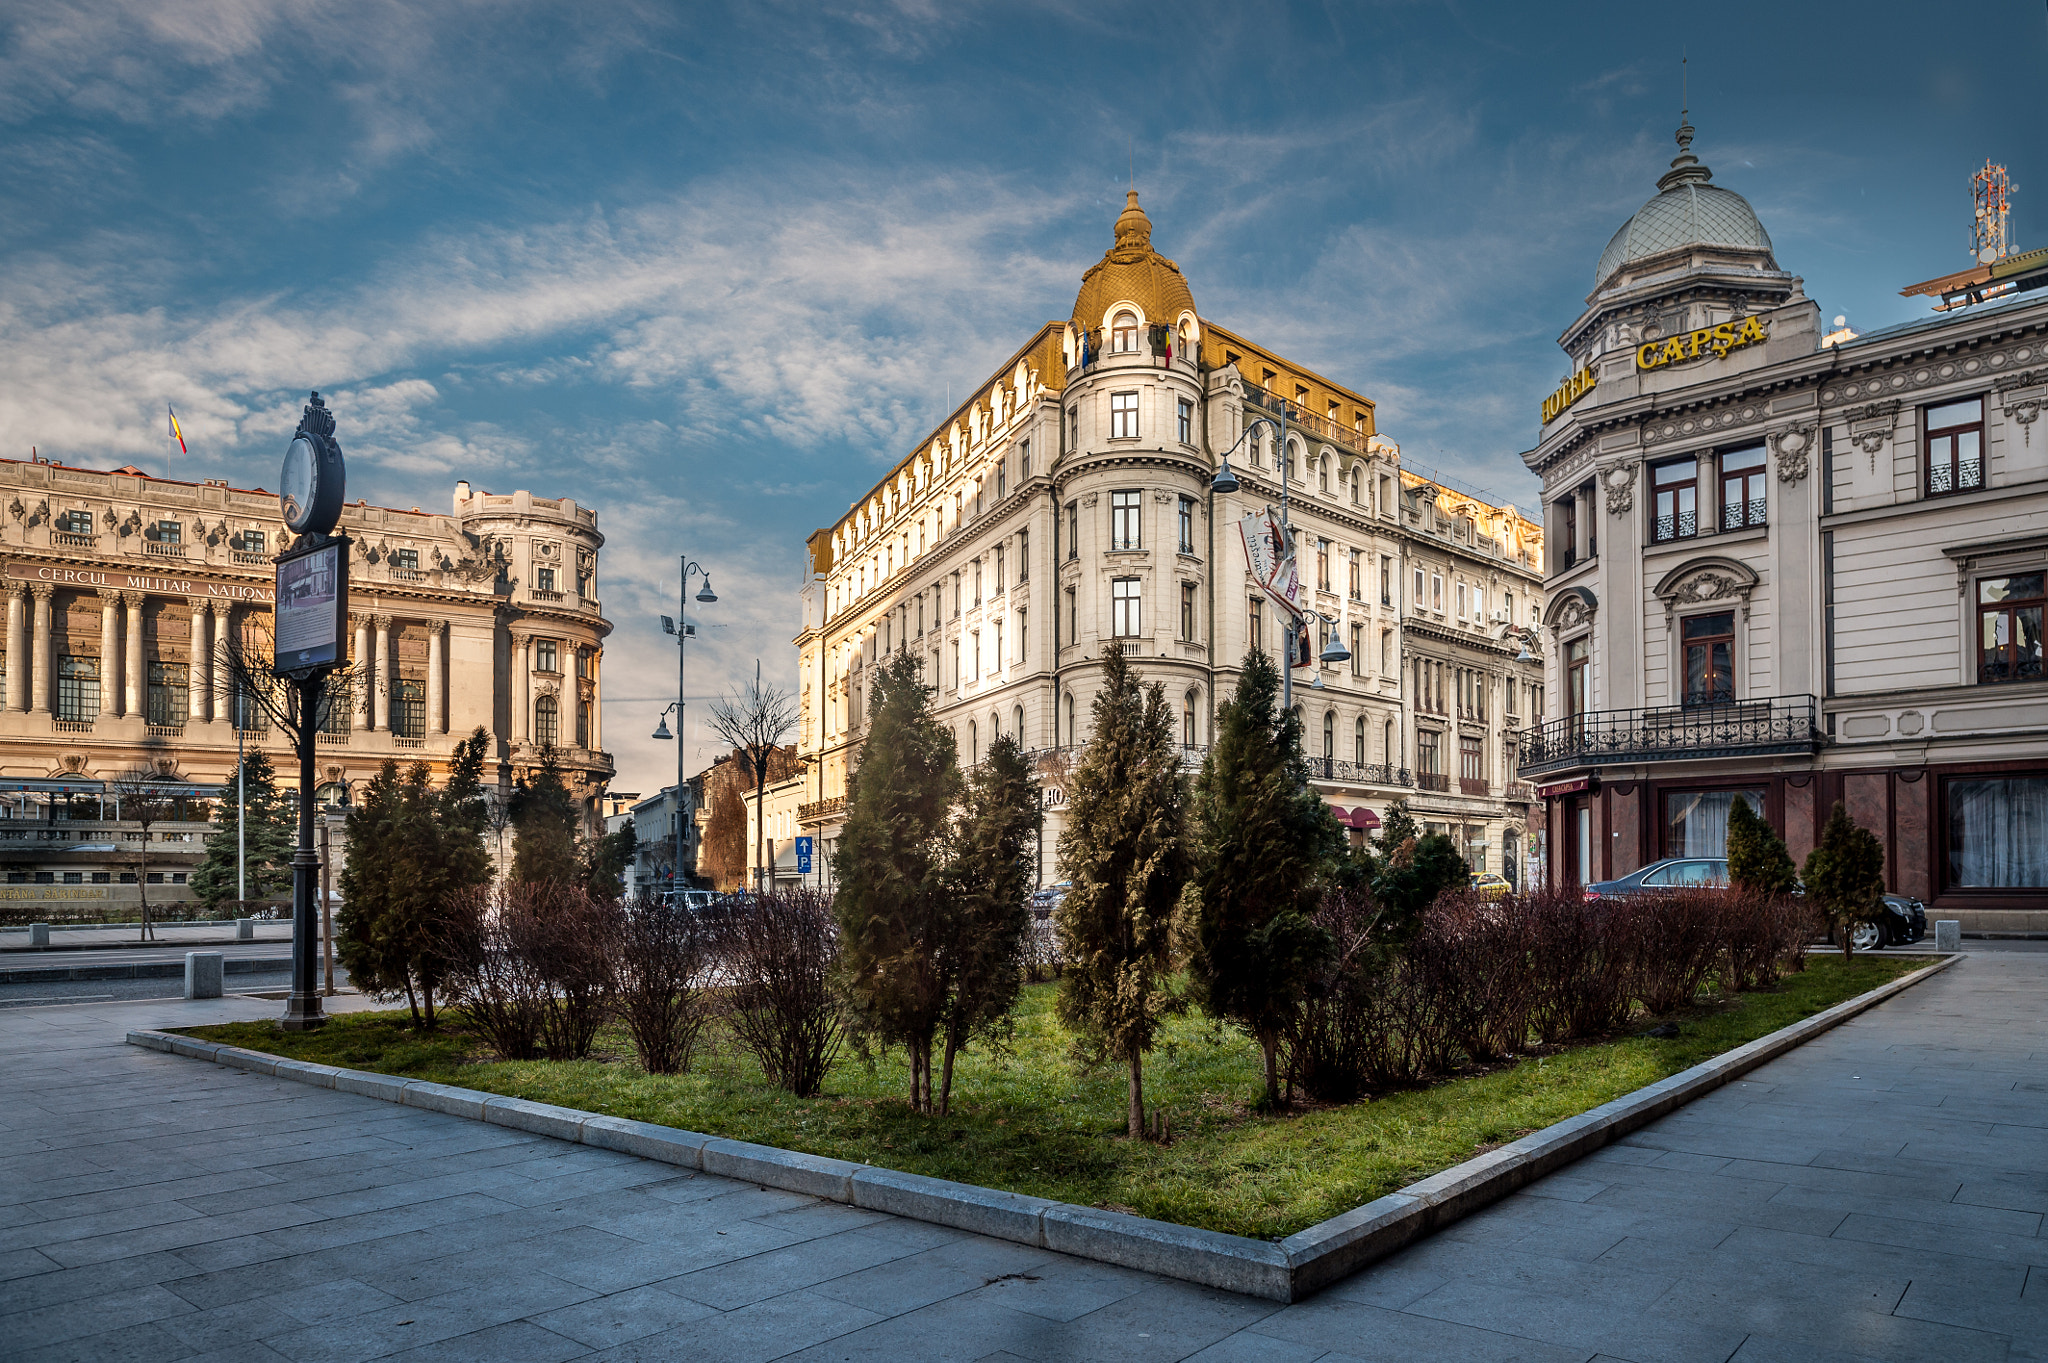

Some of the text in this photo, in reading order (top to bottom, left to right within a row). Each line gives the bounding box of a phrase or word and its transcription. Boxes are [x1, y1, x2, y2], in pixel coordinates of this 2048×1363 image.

[1541, 366, 1596, 425] HOTEL
[38, 567, 275, 601] CERCUL MILITAR NATIONA
[1047, 787, 1064, 805] HO
[801, 857, 808, 867] P
